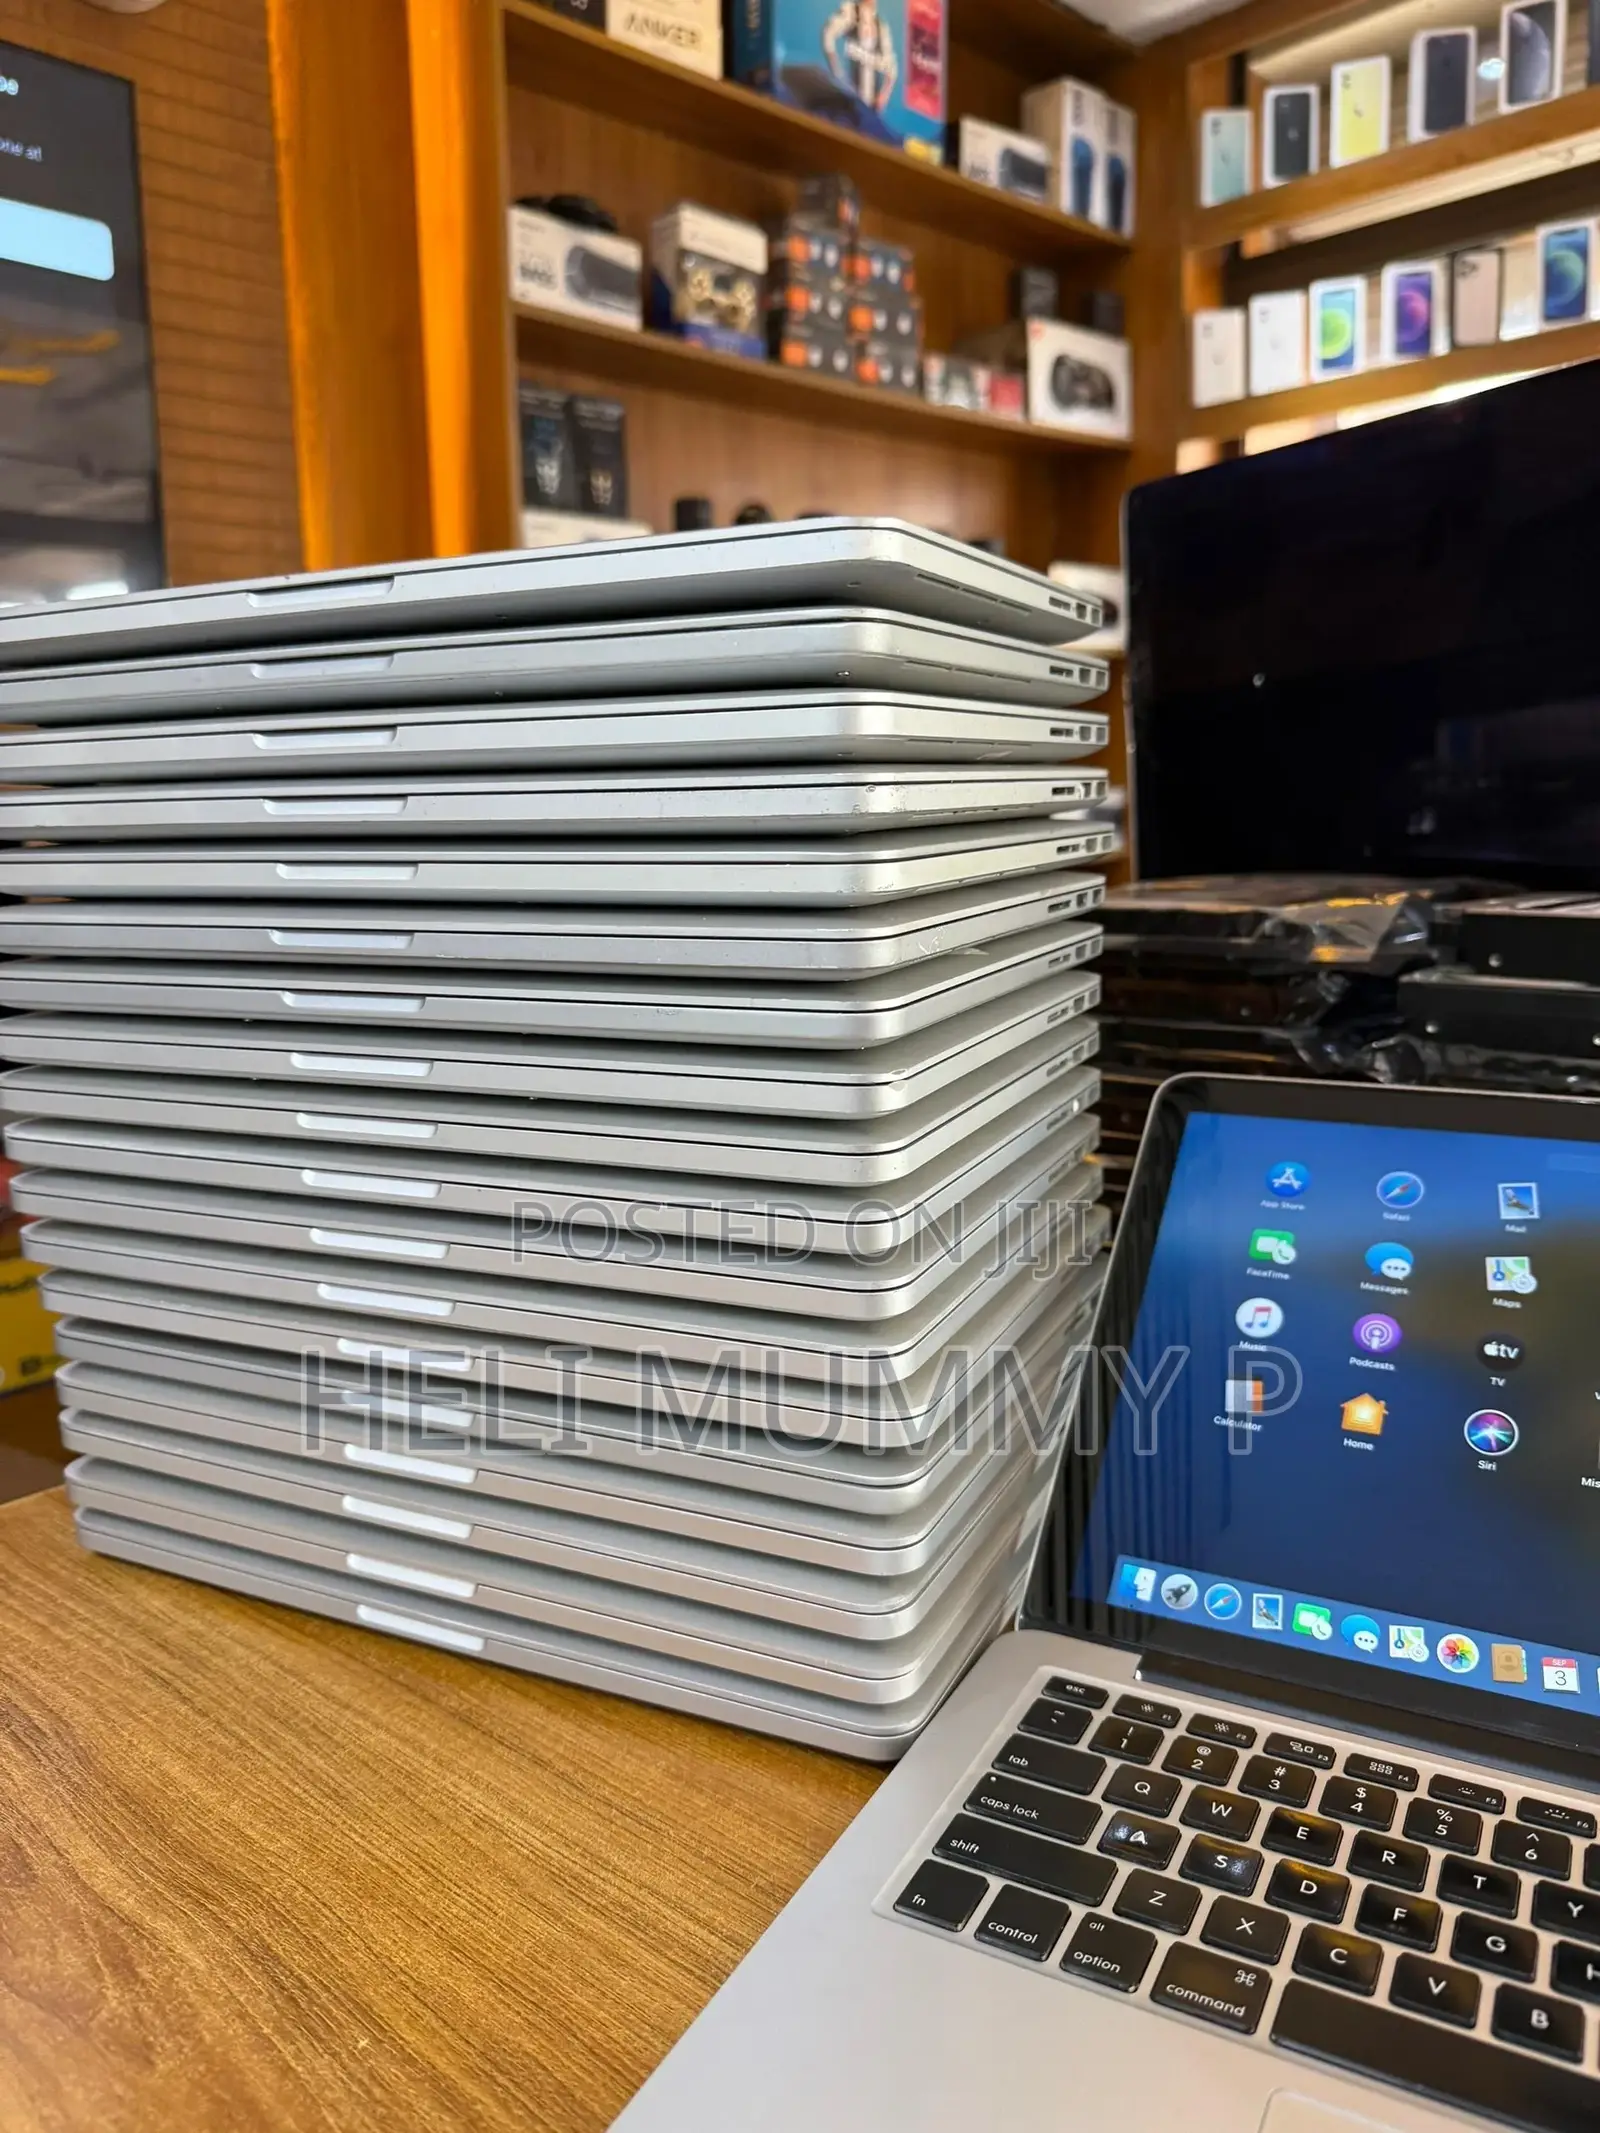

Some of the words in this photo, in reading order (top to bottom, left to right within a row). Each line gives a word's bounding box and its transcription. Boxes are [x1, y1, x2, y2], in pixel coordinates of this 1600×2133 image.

[1260, 1200, 1279, 1209] App
[1281, 1201, 1306, 1211] Store
[1383, 1212, 1411, 1222] Safari
[1505, 1224, 1527, 1234] Mail
[1246, 1266, 1290, 1281] FaceTime
[1360, 1281, 1410, 1296] Messages
[1492, 1297, 1522, 1309] Maps
[1239, 1340, 1268, 1353] Music
[1349, 1356, 1396, 1371] Podcasts
[1489, 1376, 1506, 1387] TV
[1213, 1415, 1263, 1432] Calculator
[1343, 1437, 1375, 1451] Home
[1478, 1459, 1498, 1471] Siri
[1552, 1658, 1568, 1667] SEP
[1554, 1669, 1567, 1687] 3
[1065, 1683, 1086, 1695] esc
[1162, 1713, 1173, 1721] F1
[1120, 1737, 1128, 1749] 1
[1236, 1733, 1248, 1741] F2
[1196, 1745, 1212, 1757] @
[1317, 1753, 1330, 1762] F3
[1008, 1753, 1029, 1767] tab
[1190, 1758, 1205, 1770] 2
[1273, 1765, 1287, 1777] #
[1398, 1774, 1410, 1783] F4
[1134, 1780, 1151, 1796] Q
[1268, 1779, 1282, 1791] 3
[1355, 1786, 1367, 1799] $
[980, 1794, 1011, 1812] caps
[1012, 1803, 1040, 1821] lock
[1350, 1801, 1364, 1813] 4
[1485, 1796, 1498, 1805] F5
[1211, 1800, 1233, 1818] W
[1436, 1808, 1454, 1823] %
[1434, 1824, 1449, 1837] 5
[1576, 1820, 1590, 1829] F6
[1129, 1830, 1149, 1846] A
[1296, 1825, 1310, 1841] E
[949, 1836, 981, 1855] shift
[1214, 1854, 1229, 1870] S
[1381, 1849, 1397, 1866] R
[1524, 1848, 1539, 1861] 6
[1299, 1879, 1318, 1896] D
[1472, 1874, 1488, 1890] T
[911, 1893, 927, 1907] fn
[1148, 1889, 1168, 1907] Z
[1392, 1907, 1409, 1923] F
[1567, 1900, 1585, 1919] Y
[987, 1919, 1040, 1945] control
[1088, 1918, 1106, 1933] alt
[1235, 1916, 1257, 1935] X
[1484, 1935, 1508, 1953] G
[1073, 1949, 1122, 1975] option
[1329, 1948, 1349, 1965] C
[1427, 1976, 1448, 1996] V
[1165, 1981, 1247, 2019] command
[1530, 2008, 1551, 2030] B
